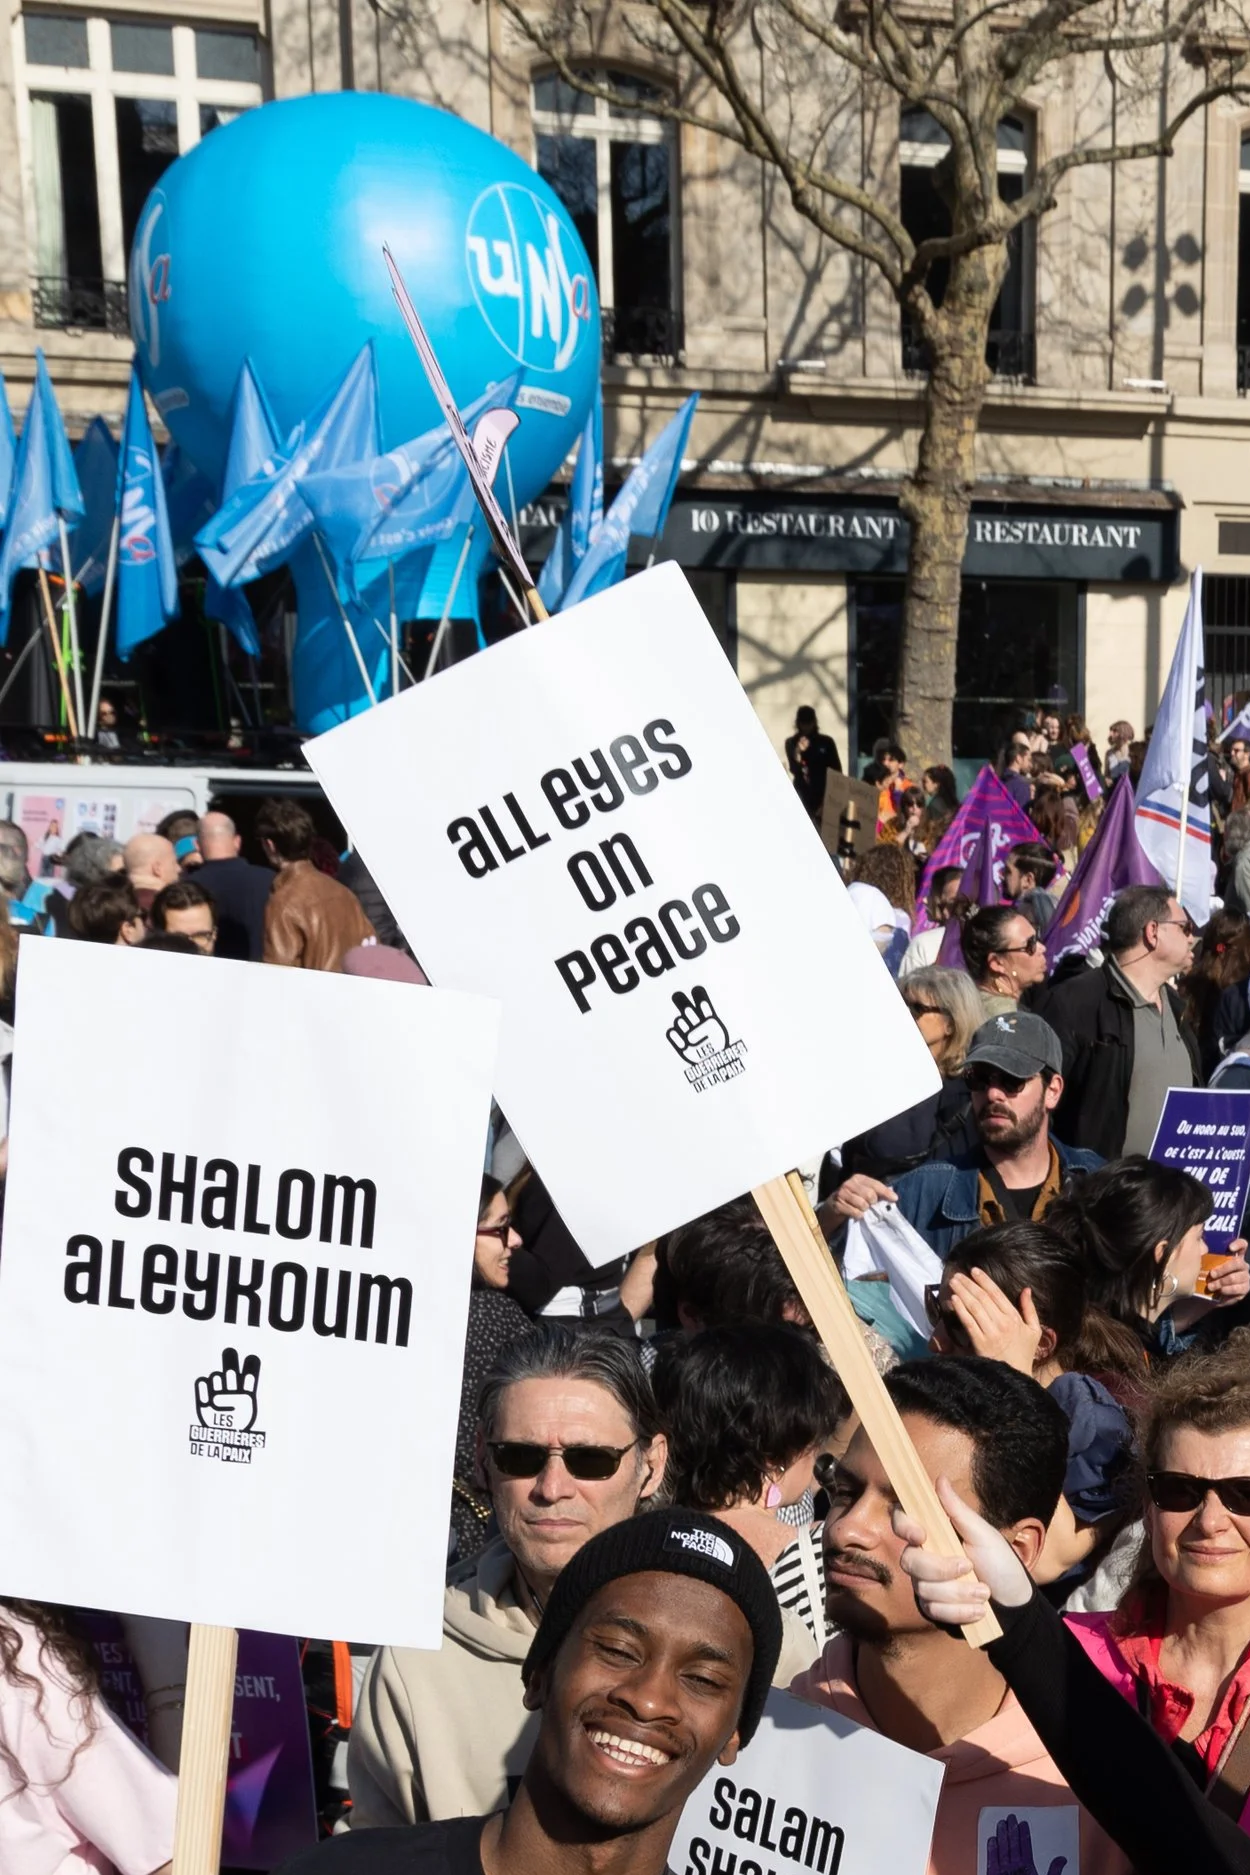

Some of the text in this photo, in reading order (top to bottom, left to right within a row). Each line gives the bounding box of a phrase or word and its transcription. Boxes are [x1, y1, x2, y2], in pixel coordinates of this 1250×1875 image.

[725, 511, 901, 540] RESTAURANT
[974, 520, 1141, 549] RESTAURANT
[541, 718, 693, 831] eyes
[566, 832, 653, 913] on
[696, 1043, 715, 1059] LES
[693, 1060, 744, 1093] DE LA PAIX
[1164, 1146, 1177, 1159] DE
[1180, 1145, 1205, 1160] L'EST
[1206, 1145, 1214, 1160] À
[1209, 1167, 1229, 1185] DE
[213, 1413, 233, 1427] LES
[190, 1425, 265, 1448] GUERRIÈRES
[191, 1443, 251, 1463] DE LA PAIX
[671, 1531, 716, 1547] NORTH
[692, 1528, 716, 1541] THE
[682, 1540, 713, 1556] FACE
